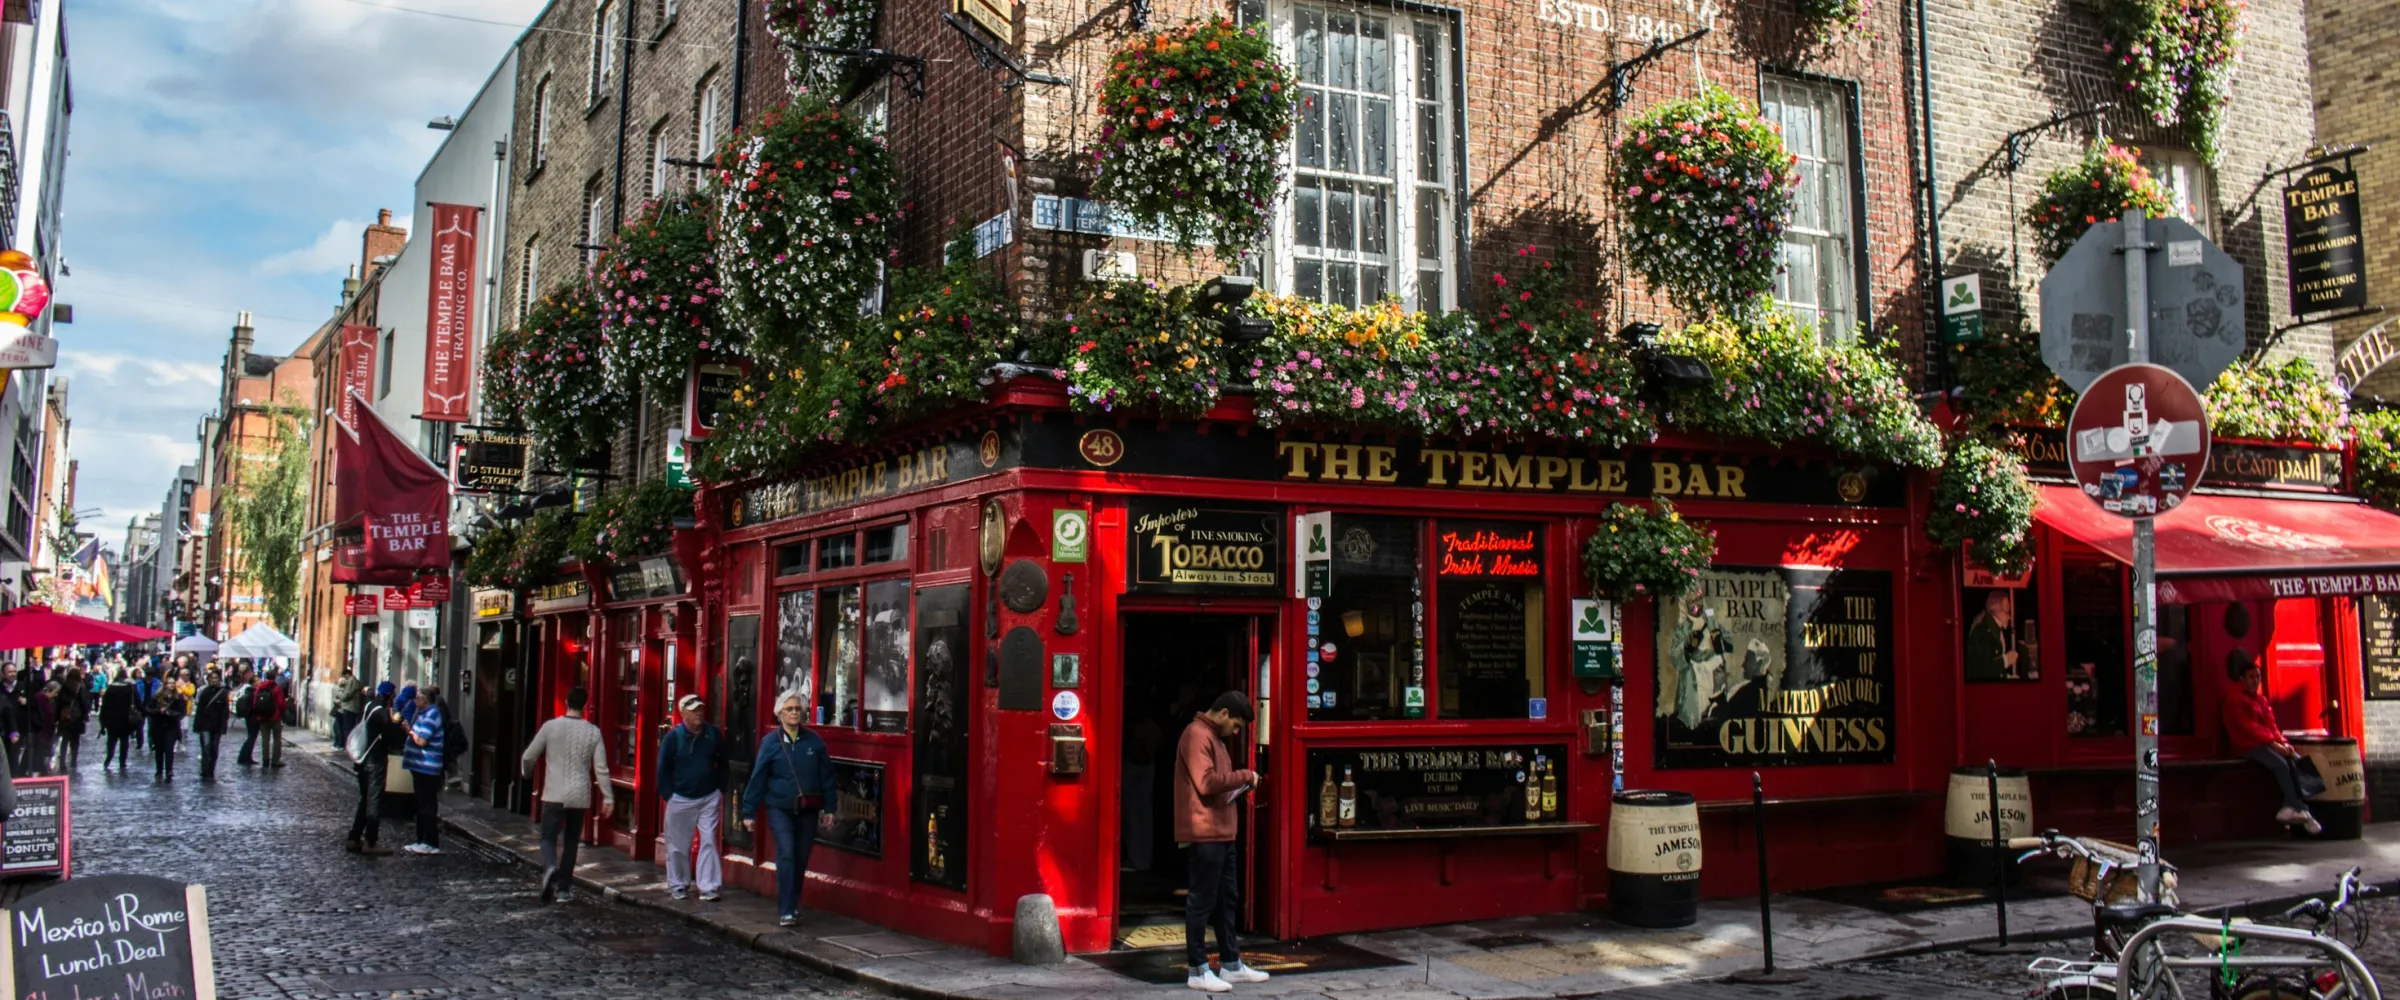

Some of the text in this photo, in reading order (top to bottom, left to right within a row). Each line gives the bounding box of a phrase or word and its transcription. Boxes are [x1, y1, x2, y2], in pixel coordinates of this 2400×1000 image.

[2307, 171, 2331, 187] THE
[2286, 180, 2356, 208] TEMPLE
[2303, 202, 2341, 222] BAR
[2292, 235, 2357, 256] BEER GARDEN
[2296, 273, 2357, 293] LIVE MUSIC
[2310, 288, 2344, 303] DAILY
[434, 243, 455, 385] THE TEMPLE BAR
[453, 268, 468, 361] TRADING CO.
[356, 353, 368, 377] THE
[2341, 324, 2394, 386] THE
[484, 434, 517, 445] TEMPLE
[983, 439, 997, 460] 48
[1087, 433, 1115, 458] 48
[481, 476, 514, 485] STORE
[805, 460, 887, 509] TEMPLE
[897, 445, 949, 490] BAR
[1279, 440, 1747, 499] THE TEMPLE BAR
[391, 512, 421, 524] THE
[1134, 507, 1199, 535] Importers
[1174, 523, 1186, 532] OF
[369, 521, 442, 539] TEMPLE
[1191, 530, 1263, 543] FINE SMOKING
[1443, 529, 1534, 552] Traditional
[389, 538, 427, 552] BAR
[1151, 535, 1264, 578] TOBACCO
[1440, 553, 1538, 576] Irish Music
[1175, 570, 1273, 583] Always in Stock
[2269, 577, 2305, 597] THE
[2307, 575, 2372, 595] TEMPLE
[1460, 589, 1500, 611] TEMPLE
[1700, 578, 1784, 600] TEMPLE
[1726, 599, 1766, 621] BAR
[1844, 596, 1876, 620] THE
[1804, 622, 1876, 648] EMPEROR
[1858, 653, 1877, 676] OF
[1758, 678, 1884, 715] MALTED LIQUORS
[1719, 717, 1886, 755] GUINNESS
[1359, 751, 1400, 772] THE
[1404, 750, 1480, 772] TEMPLE
[1423, 772, 1463, 783] DUBLIN
[1405, 800, 1480, 814] LIVE MUSIC DAILY
[1970, 792, 1986, 801] THE
[11, 806, 56, 817] OFFEE
[1974, 808, 2026, 826] JAESON
[1648, 826, 1666, 836] THE
[6, 843, 56, 855] DONUTS
[19, 893, 186, 947] Mexico to Rome
[42, 932, 166, 979] Lunch Deal
[126, 972, 186, 1000] Main
